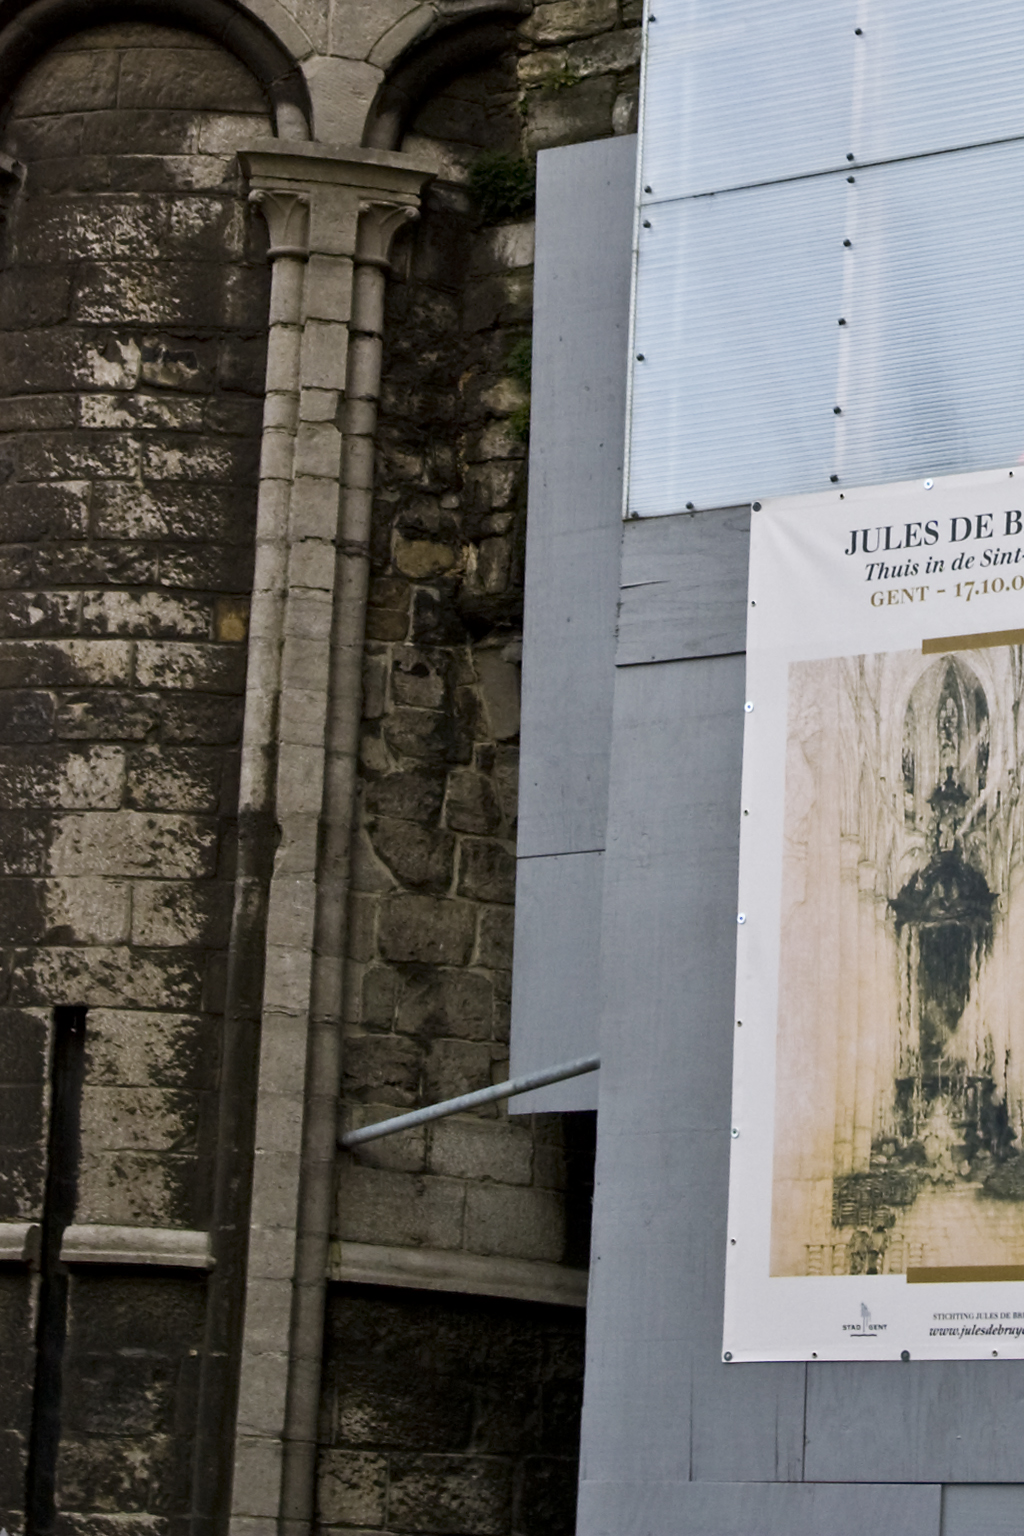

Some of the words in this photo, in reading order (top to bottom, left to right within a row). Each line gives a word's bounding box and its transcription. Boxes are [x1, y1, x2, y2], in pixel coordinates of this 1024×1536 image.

[844, 519, 939, 556] JULES
[948, 513, 994, 543] DE
[864, 555, 920, 582] Thuis
[925, 556, 946, 575] in
[951, 552, 976, 571] de
[870, 585, 930, 608] GENT
[868, 1323, 888, 1331] GENT
[933, 1312, 974, 1321] STICHTING
[975, 1312, 999, 1320] JULES
[1000, 1312, 1011, 1320] DE
